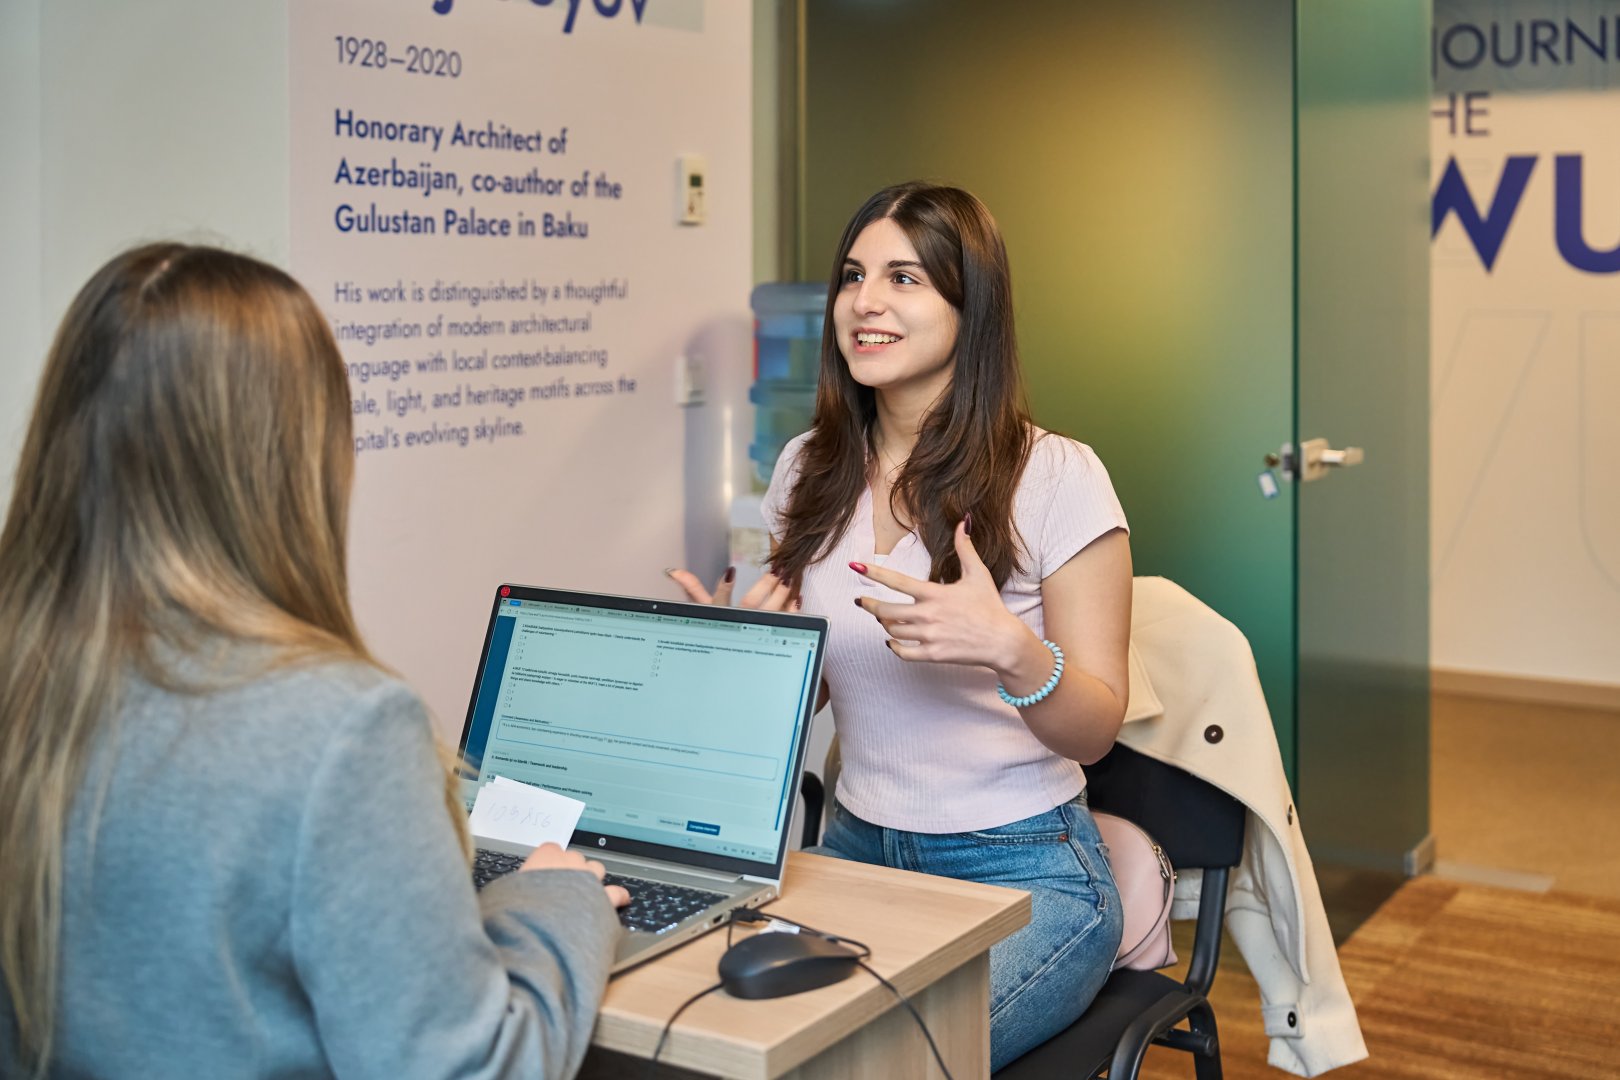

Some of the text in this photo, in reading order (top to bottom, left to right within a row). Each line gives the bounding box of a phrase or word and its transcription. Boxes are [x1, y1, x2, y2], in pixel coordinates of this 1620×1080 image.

[1431, 15, 1620, 80] JOURN
[334, 109, 568, 155] Honorary Architect of
[1431, 91, 1490, 137] HE
[334, 157, 623, 200] Azerbaijan, co-author of the
[334, 203, 589, 239] Gulustan Palace in Baku
[334, 279, 628, 308] His work is distinguished by a thoughtful
[335, 311, 593, 346] integration of modern architectural
[342, 360, 410, 383] anguage
[416, 350, 447, 372] with
[451, 348, 488, 371] local
[353, 373, 638, 417] ale, light, and heritage motifs across the
[355, 425, 400, 456] pital's
[405, 424, 469, 449] evolving
